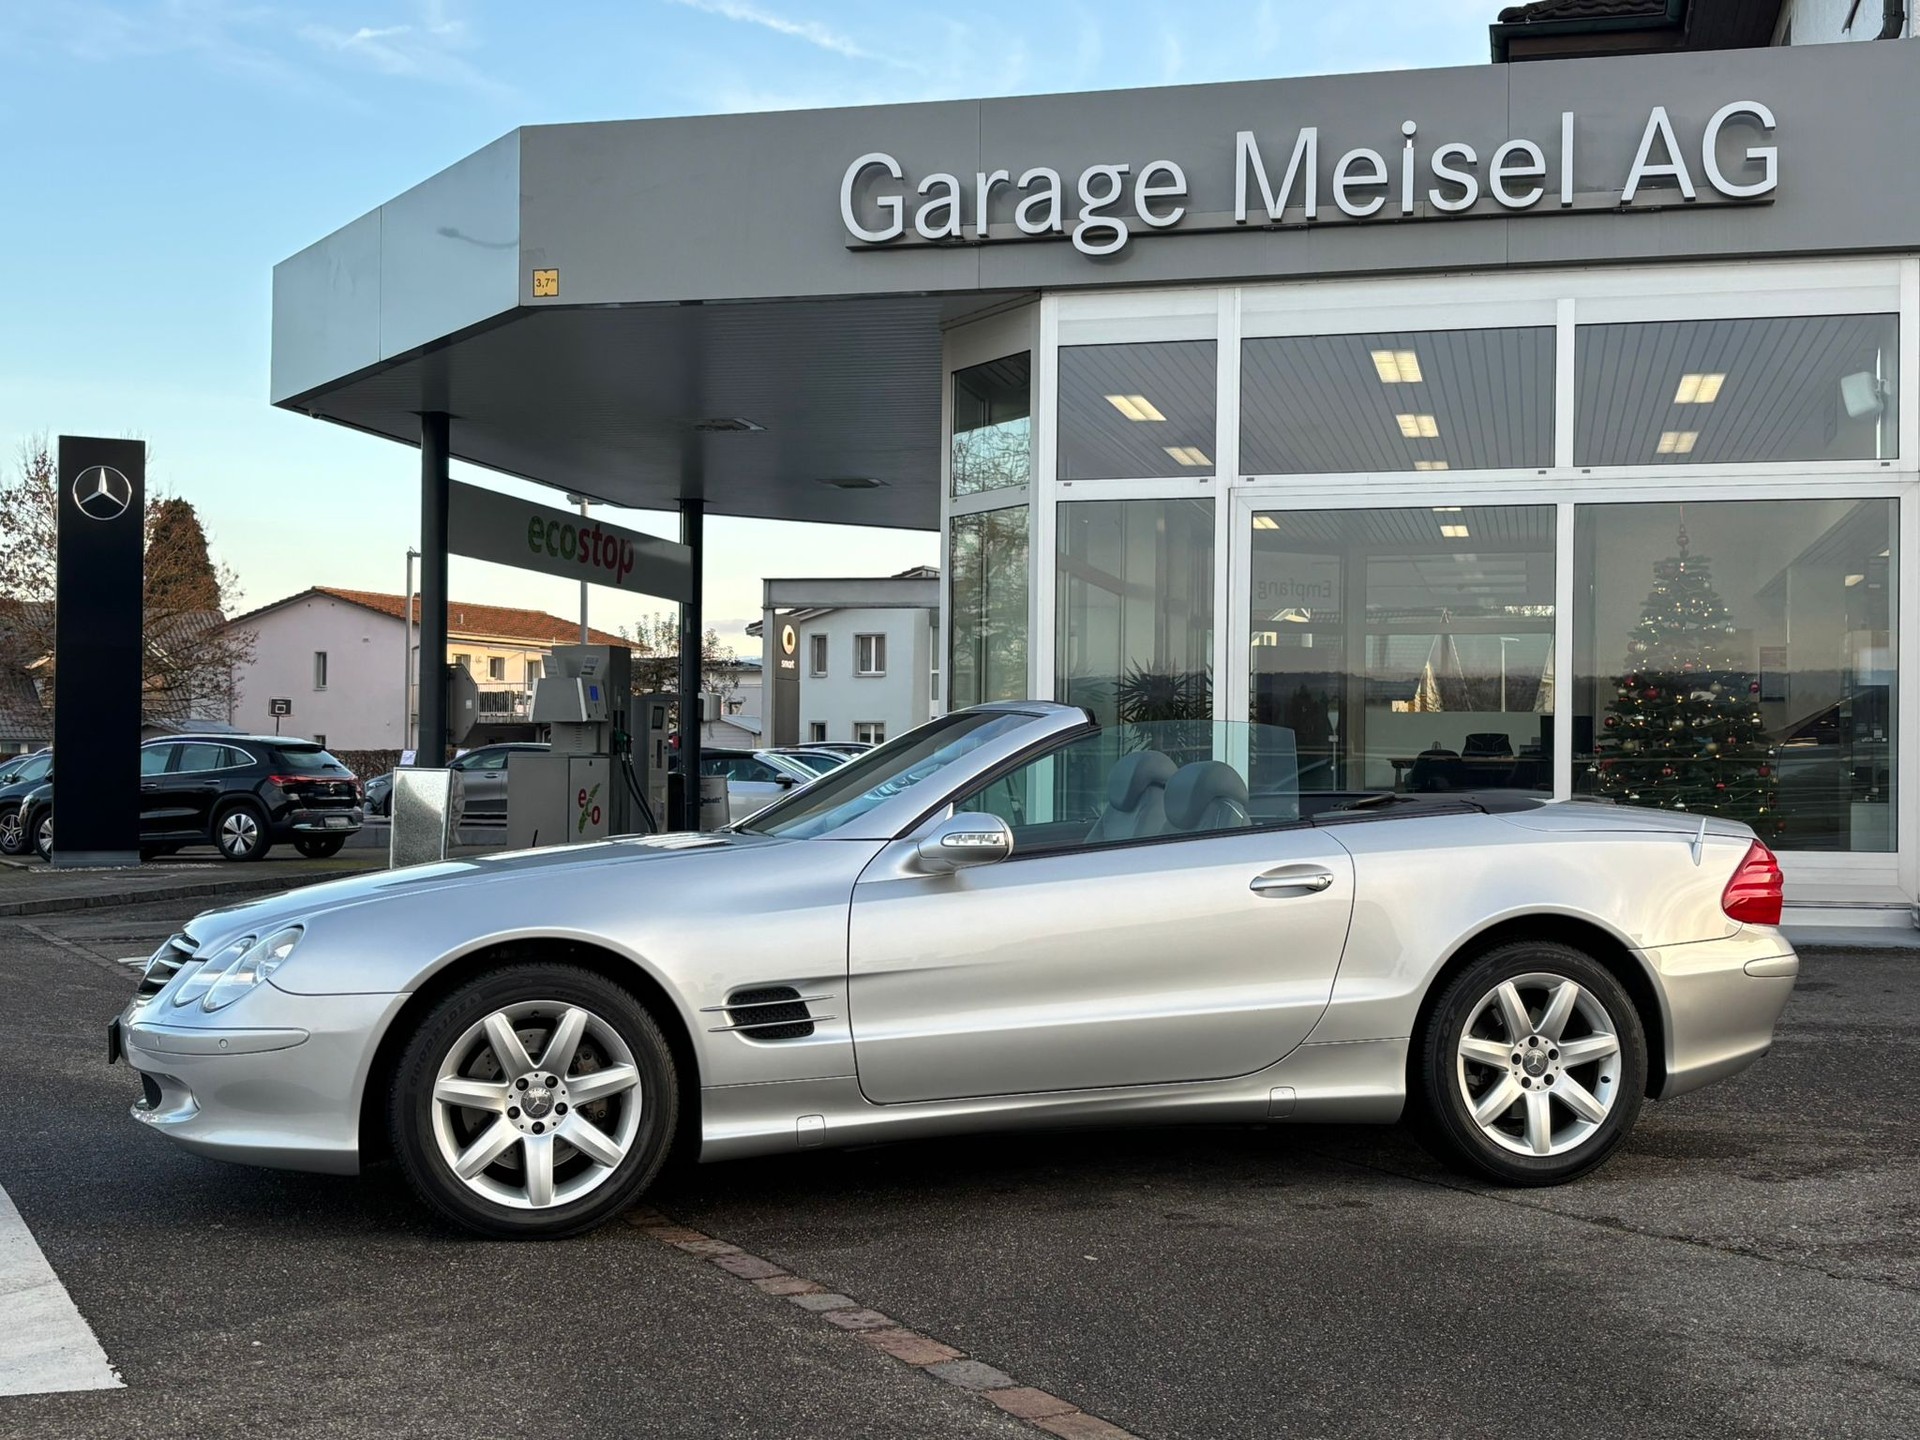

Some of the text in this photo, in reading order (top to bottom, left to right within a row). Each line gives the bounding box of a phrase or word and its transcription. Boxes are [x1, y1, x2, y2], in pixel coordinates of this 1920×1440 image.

[840, 100, 1778, 256] Garage Meisel AG
[527, 515, 634, 584] ecostop
